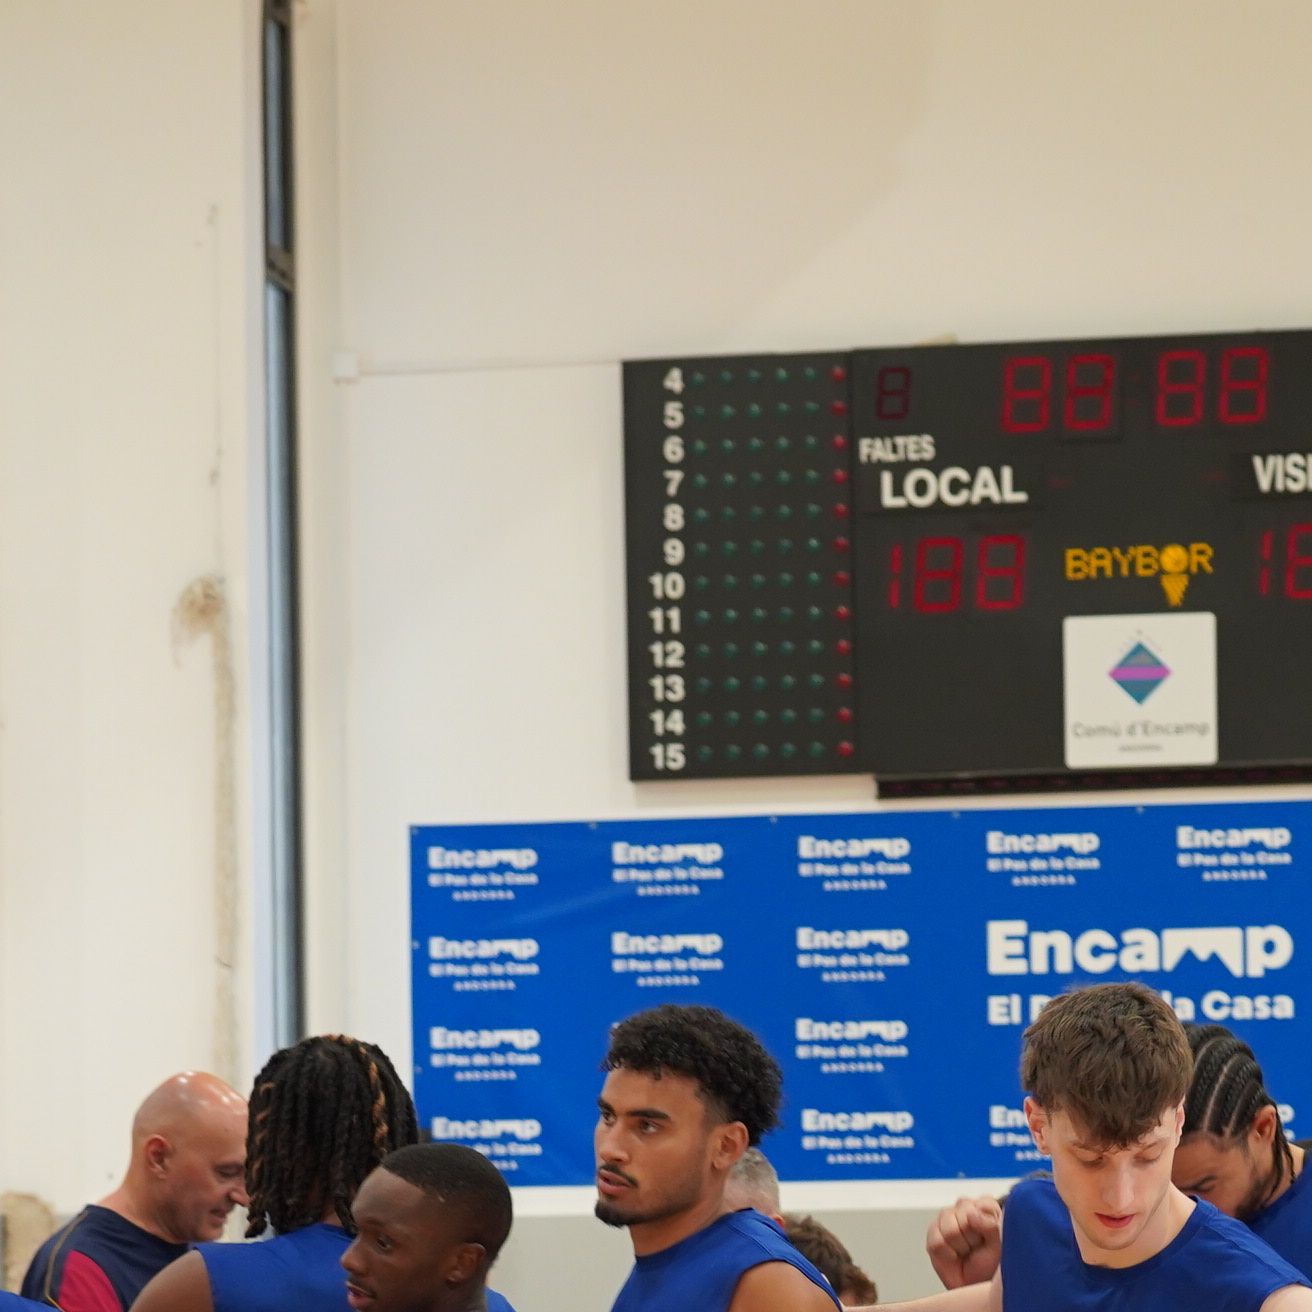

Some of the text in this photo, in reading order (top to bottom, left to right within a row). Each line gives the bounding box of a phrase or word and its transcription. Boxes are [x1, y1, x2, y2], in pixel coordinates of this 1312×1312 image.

[663, 368, 685, 394] 4
[663, 401, 685, 429] 5
[663, 435, 685, 463] 6
[858, 434, 936, 463] FALTES
[663, 470, 685, 496] 7
[880, 465, 1029, 508] LOCAL
[663, 504, 685, 531] 8
[663, 538, 685, 565] 9
[649, 572, 685, 599] 10
[649, 607, 682, 633] 11
[649, 641, 685, 668] 12
[649, 674, 686, 702] 13
[649, 709, 686, 736] 14
[649, 743, 686, 770] 15
[798, 836, 910, 859] Encamp
[987, 831, 1100, 854] Encamp
[1177, 826, 1291, 849] Encamp
[428, 847, 538, 869] Encamp
[612, 842, 723, 864] Encamp
[429, 937, 538, 960] Encamp
[612, 932, 723, 954] Encamp
[797, 927, 909, 950] Encamp
[986, 920, 1294, 978] Encamp
[987, 994, 1022, 1025] El
[1201, 990, 1295, 1020] Casa
[430, 1027, 540, 1050] Encamp
[796, 1018, 907, 1042] Encamp
[431, 1117, 541, 1140] Encamp
[802, 1109, 913, 1132] Encamp
